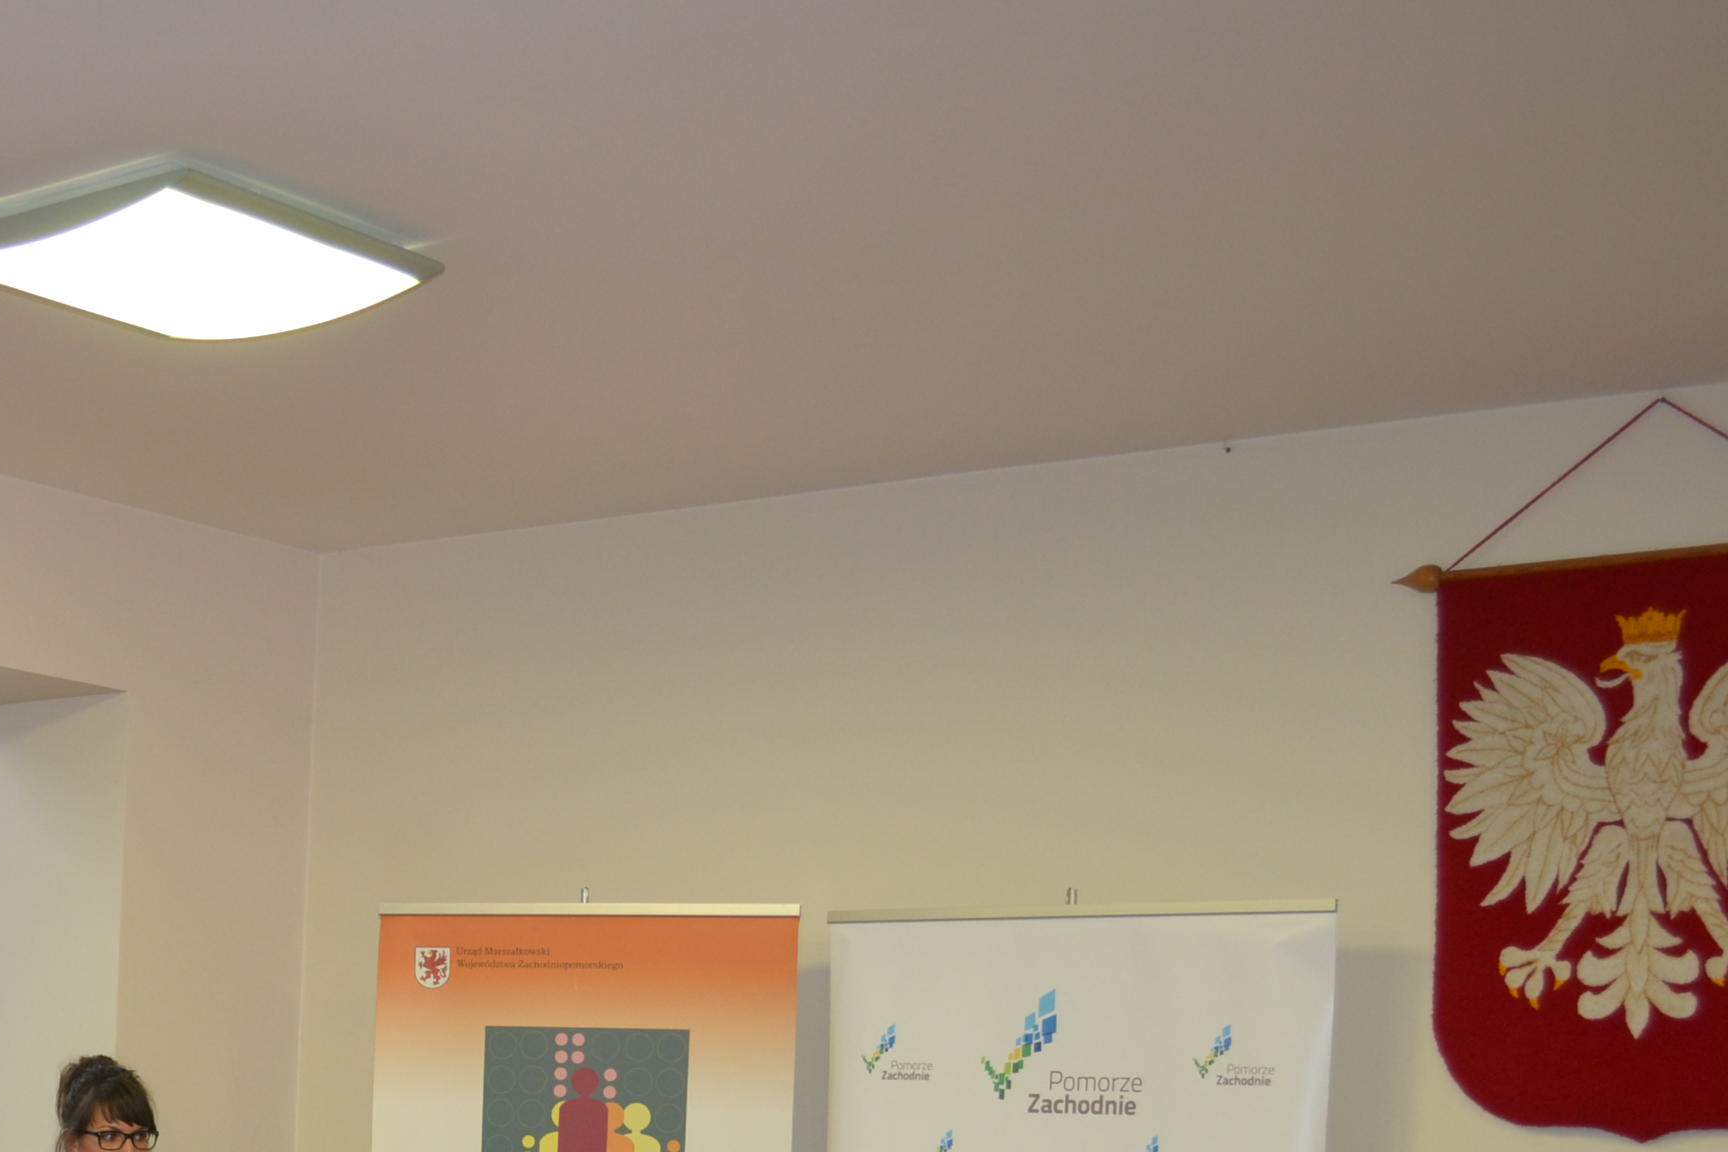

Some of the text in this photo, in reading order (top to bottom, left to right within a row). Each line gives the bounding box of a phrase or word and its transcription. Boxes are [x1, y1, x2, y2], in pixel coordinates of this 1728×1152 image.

[890, 1060, 933, 1071] Pomorze
[1226, 1063, 1275, 1076] Pomorze
[881, 1071, 931, 1081] Zachodnie
[1049, 1071, 1143, 1093] Pomorze
[1216, 1075, 1271, 1087] Zachodnie
[1027, 1093, 1137, 1116] Zachodnie
